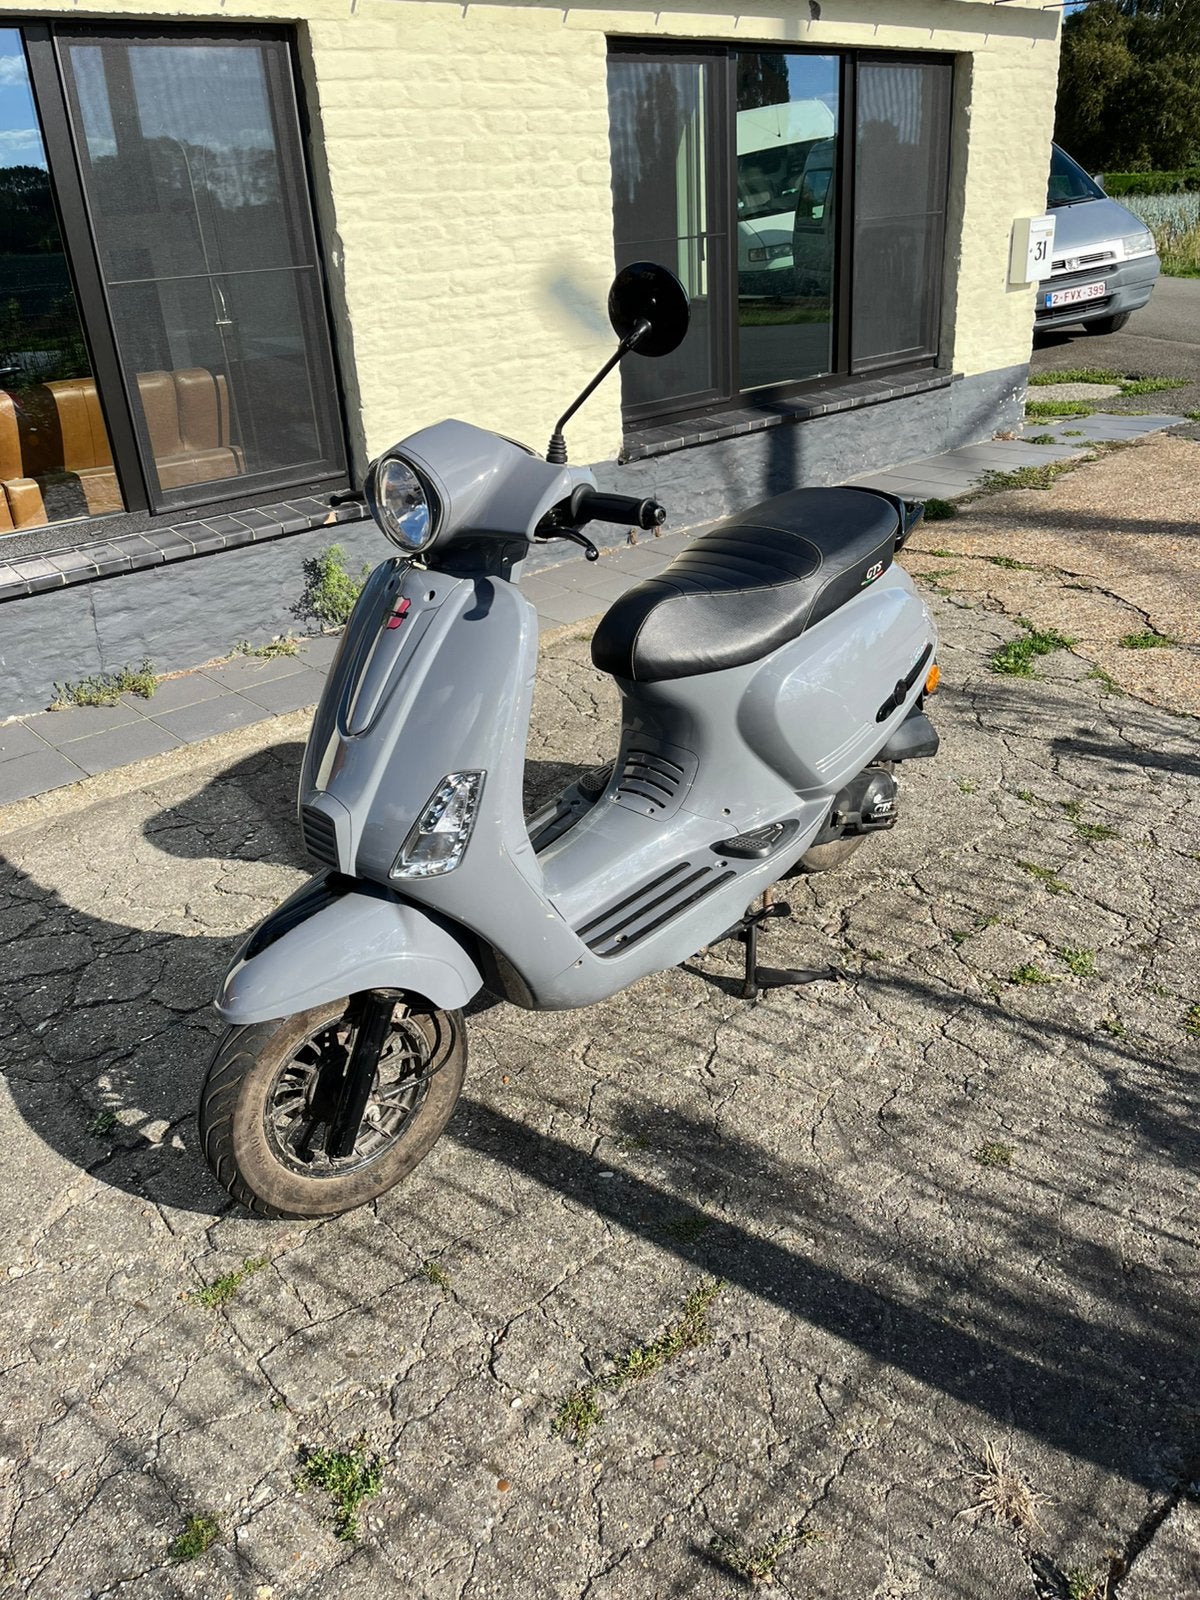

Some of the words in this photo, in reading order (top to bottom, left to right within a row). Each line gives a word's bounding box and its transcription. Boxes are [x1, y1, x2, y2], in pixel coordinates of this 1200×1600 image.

[1034, 240, 1047, 261] 31
[1053, 284, 1104, 304] 2-FVX-399
[866, 560, 883, 579] GTS
